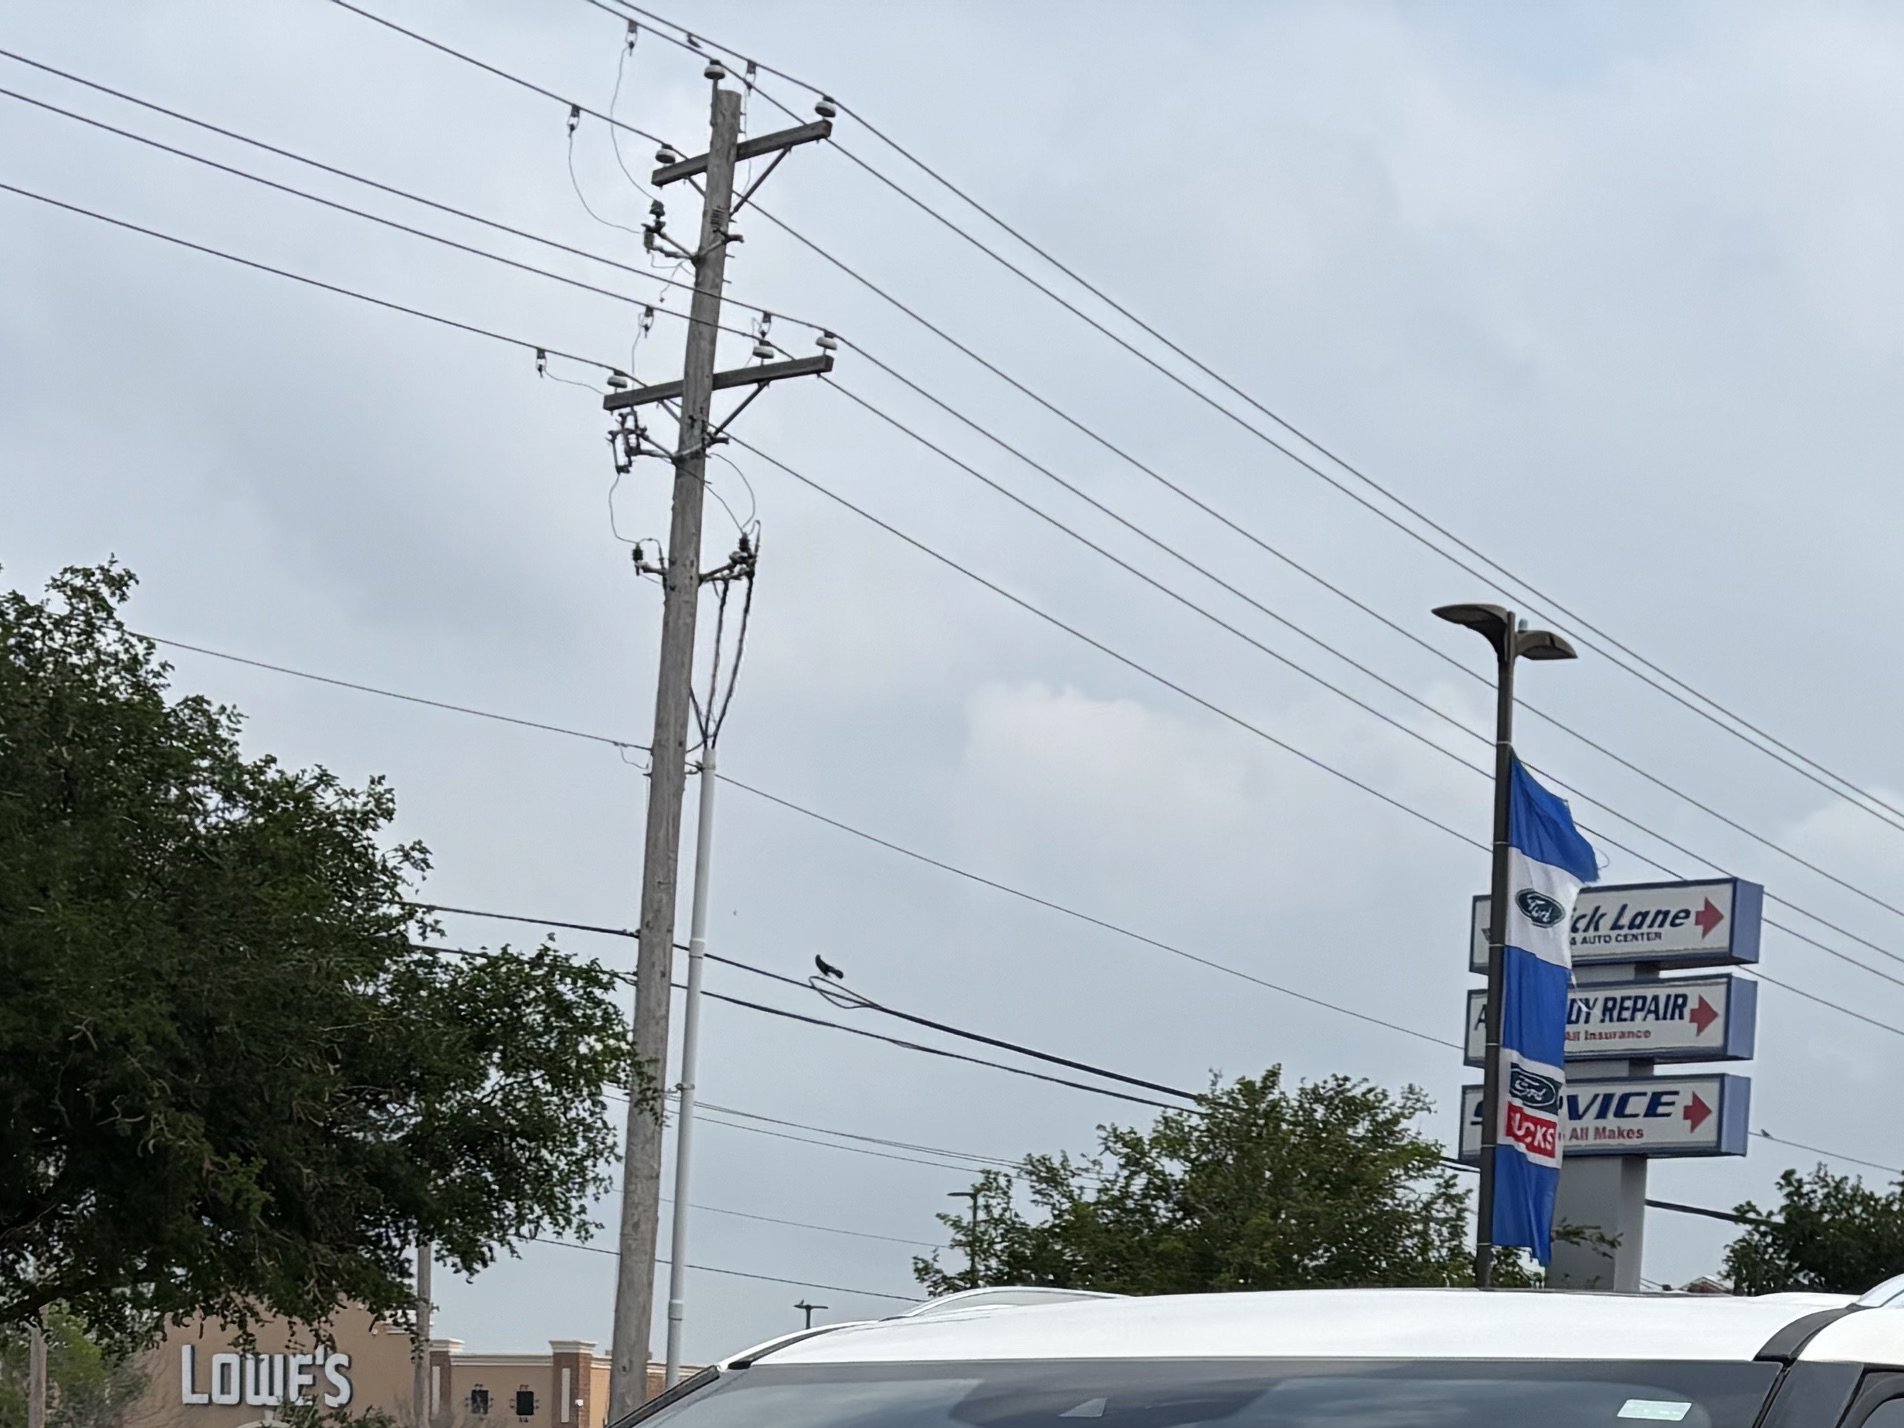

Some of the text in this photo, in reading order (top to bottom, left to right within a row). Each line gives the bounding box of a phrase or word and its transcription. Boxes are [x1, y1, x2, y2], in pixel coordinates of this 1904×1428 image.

[1610, 903, 1691, 931] Lane
[1581, 933, 1612, 946] AUTO
[1615, 932, 1663, 944] CENTER
[1599, 993, 1689, 1024] REPAIR
[1584, 1029, 1652, 1041] Insurance
[1568, 1126, 1590, 1141] All
[1593, 1125, 1644, 1140] Makes
[181, 1344, 352, 1408] LOWE'S
